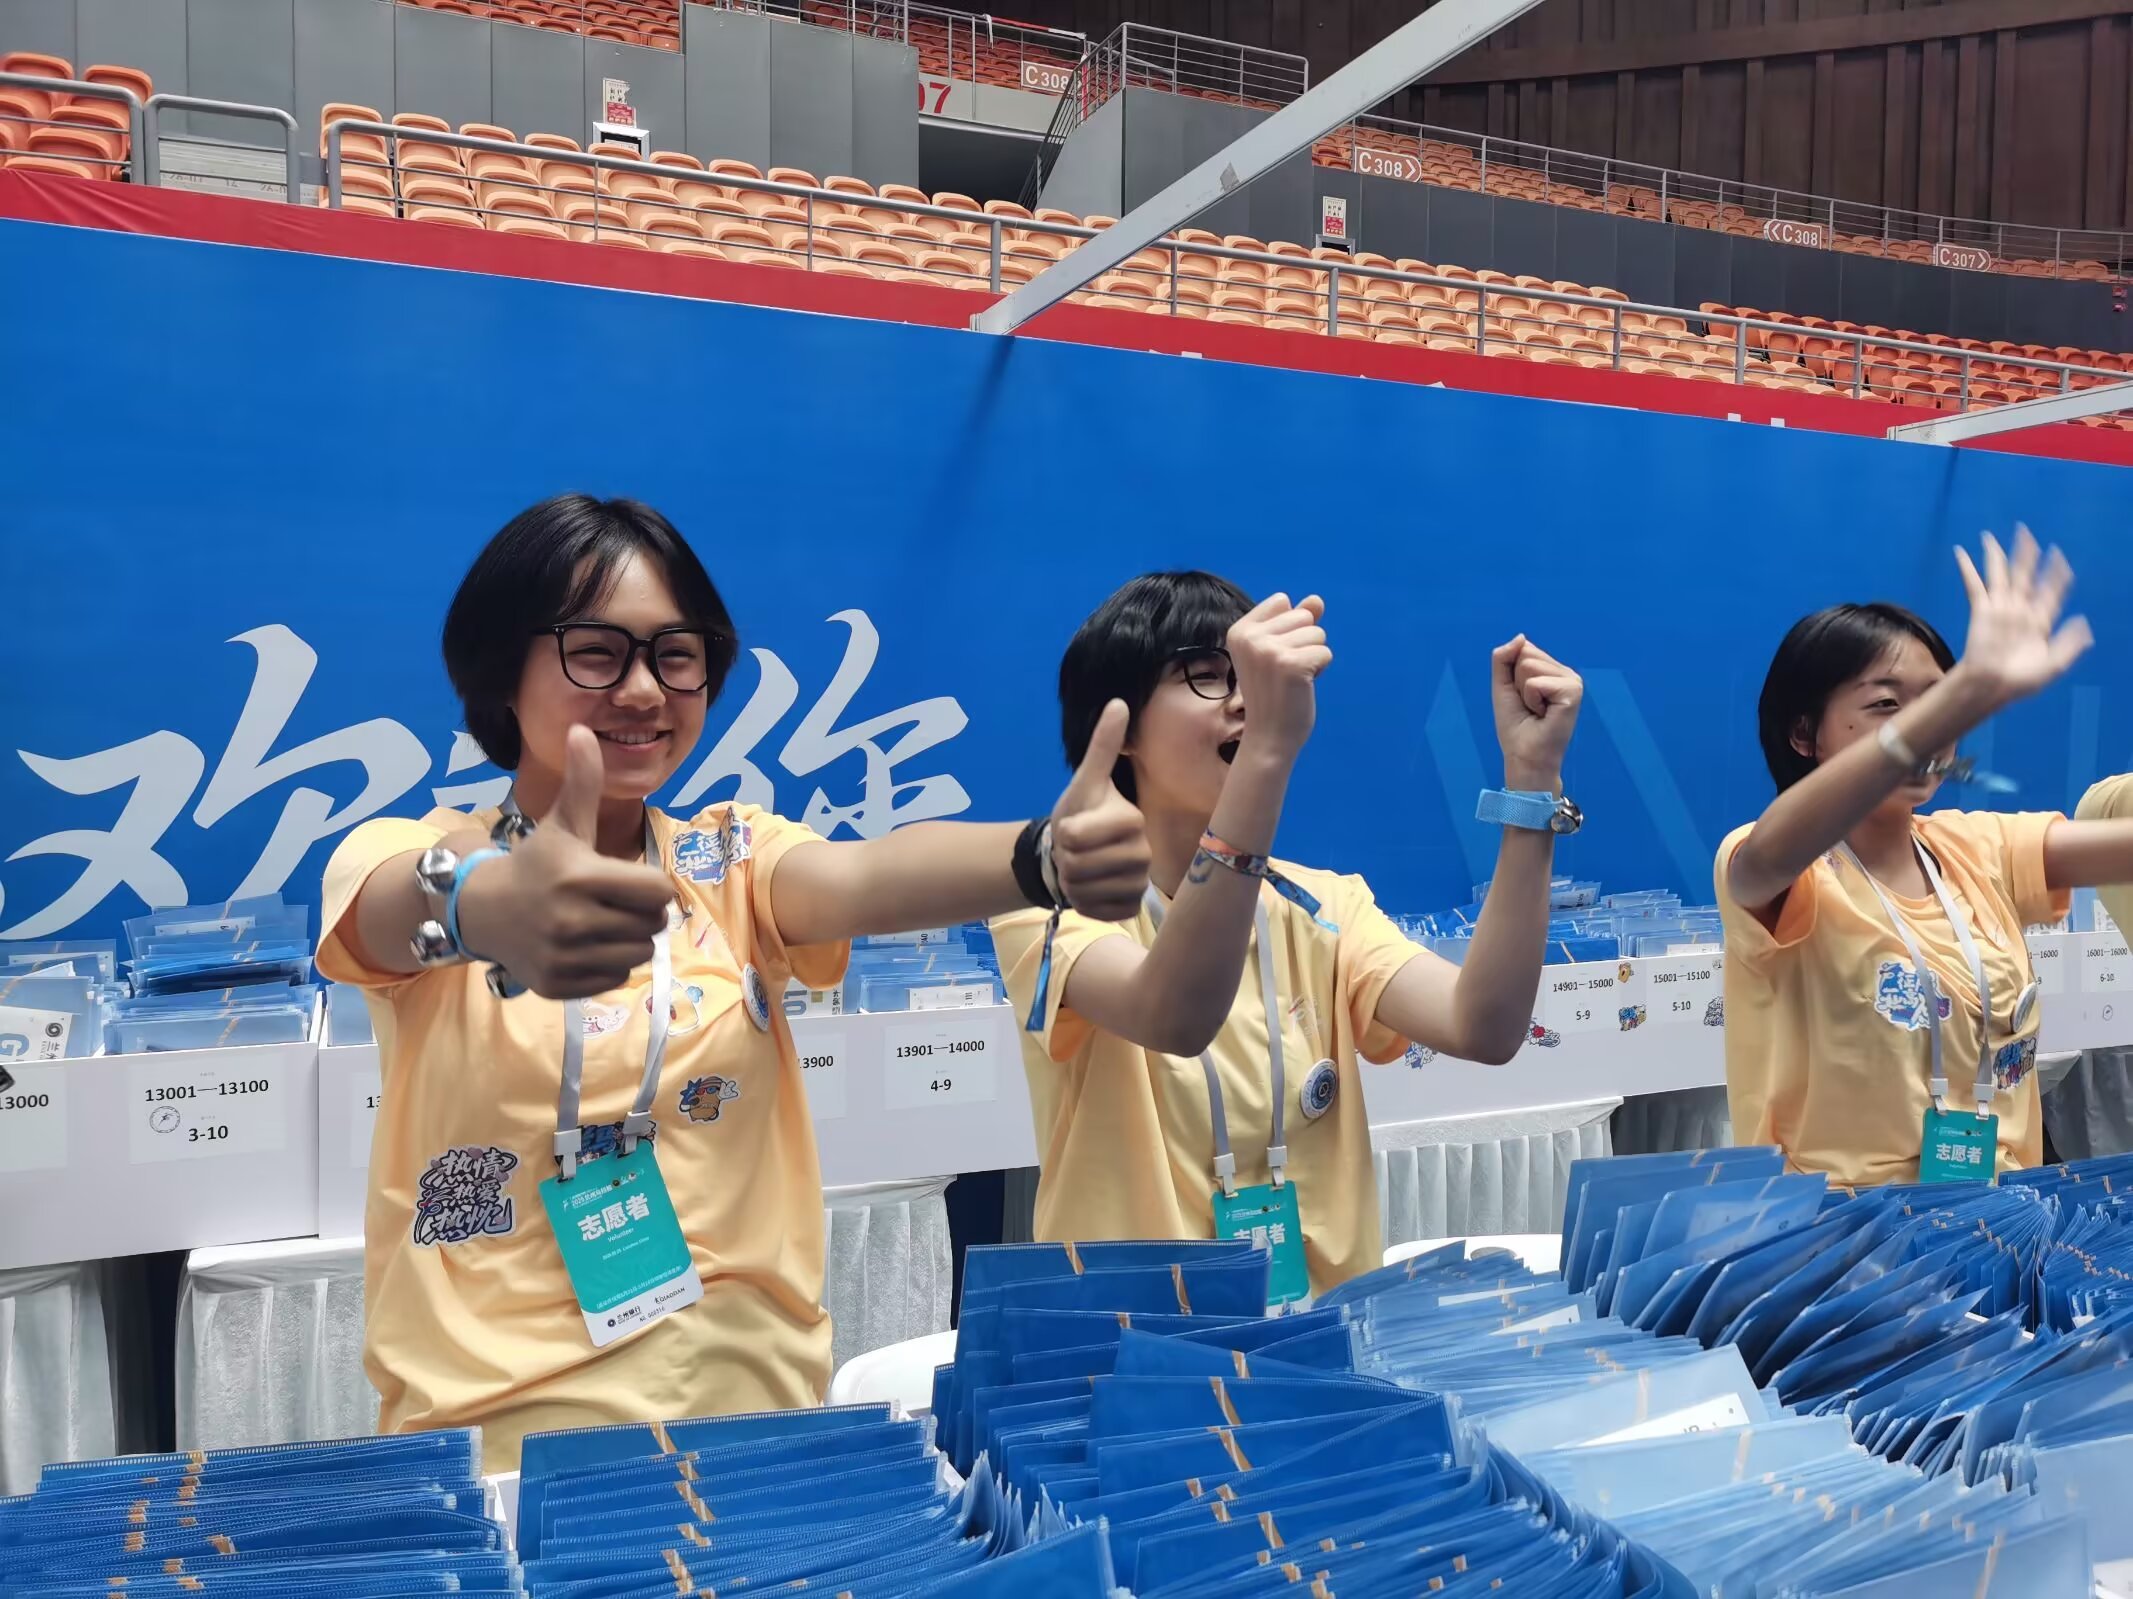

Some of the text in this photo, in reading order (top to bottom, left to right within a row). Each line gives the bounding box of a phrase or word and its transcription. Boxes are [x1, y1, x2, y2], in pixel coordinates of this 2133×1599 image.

[1672, 1001, 1691, 1011] 5-10
[1575, 1010, 1591, 1021] 5-9
[930, 1079, 952, 1092] 4-9
[188, 1125, 229, 1142] 3-10
[1935, 1142, 1983, 1165] 志愿者
[577, 1192, 650, 1242] 志愿者
